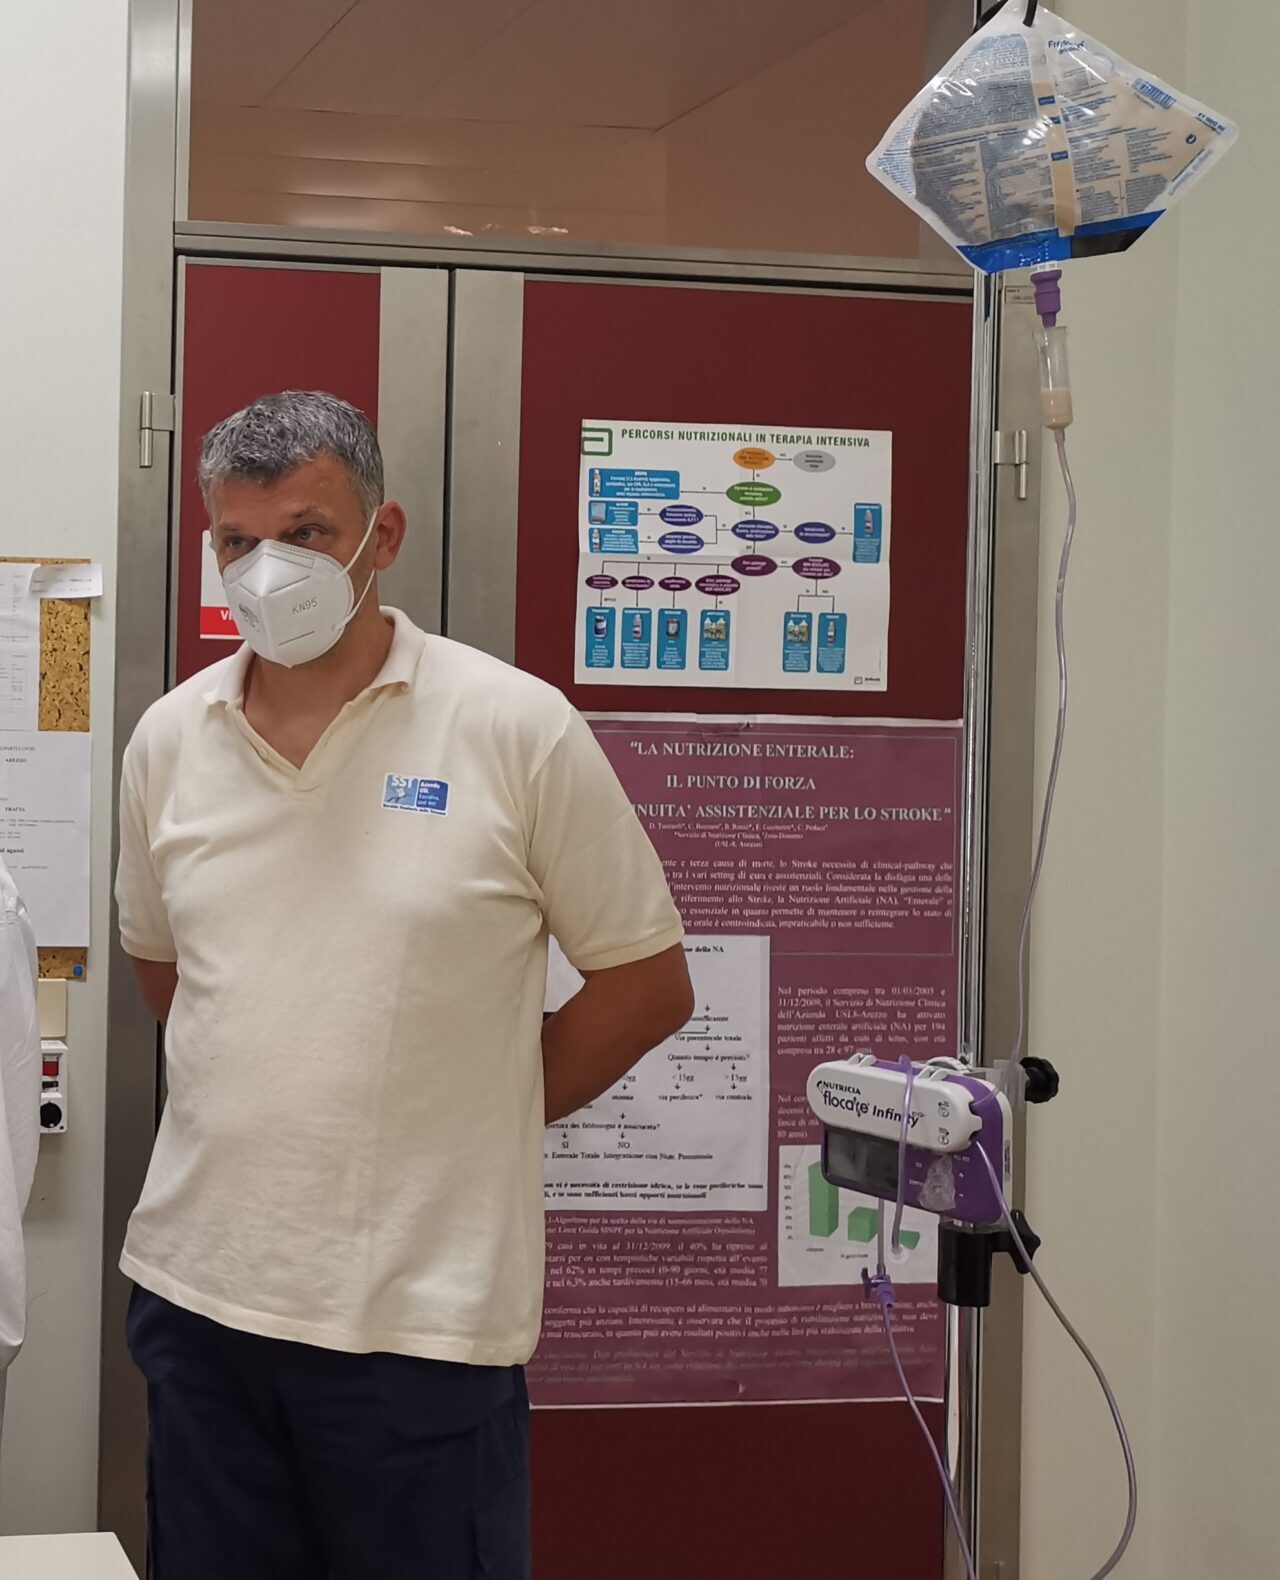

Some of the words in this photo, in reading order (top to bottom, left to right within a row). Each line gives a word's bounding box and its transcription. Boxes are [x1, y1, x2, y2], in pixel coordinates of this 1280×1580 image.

[621, 428, 674, 440] PERCORSI
[678, 430, 752, 443] NUTRIZIONALI
[756, 432, 766, 443] IN
[770, 433, 813, 445] TERAPIA
[816, 435, 870, 448] INTENSIVA
[291, 597, 318, 615] KN95
[663, 742, 762, 757] NUTRIZIONE
[766, 744, 854, 759] ENTERALE:
[667, 775, 682, 788] IL
[687, 775, 738, 789] PUNTO
[744, 776, 760, 789] DI
[765, 776, 816, 790] FORZA
[696, 805, 814, 820] ASSISTENZIALE
[820, 806, 850, 820] PER
[854, 807, 876, 820] LO
[690, 860, 710, 868] terza
[713, 860, 734, 868] causa
[738, 860, 746, 868] di
[780, 860, 787, 868] lo
[792, 860, 818, 868] Stroke
[860, 860, 868, 868] di
[710, 871, 736, 881] setting
[738, 871, 746, 879] di
[874, 872, 882, 880] la
[714, 882, 760, 892] nutrizionale
[802, 884, 823, 892] ruolo
[826, 883, 876, 892] fondamentale
[879, 884, 898, 892] nella
[681, 895, 724, 903] riferimento
[728, 894, 742, 903] allo
[789, 894, 830, 904] Nutrizione
[690, 907, 728, 916] essenziale
[694, 918, 712, 927] orale
[823, 1081, 862, 1095] NUTRICIA
[872, 1105, 919, 1128] Infinty
[618, 1142, 630, 1150] NO
